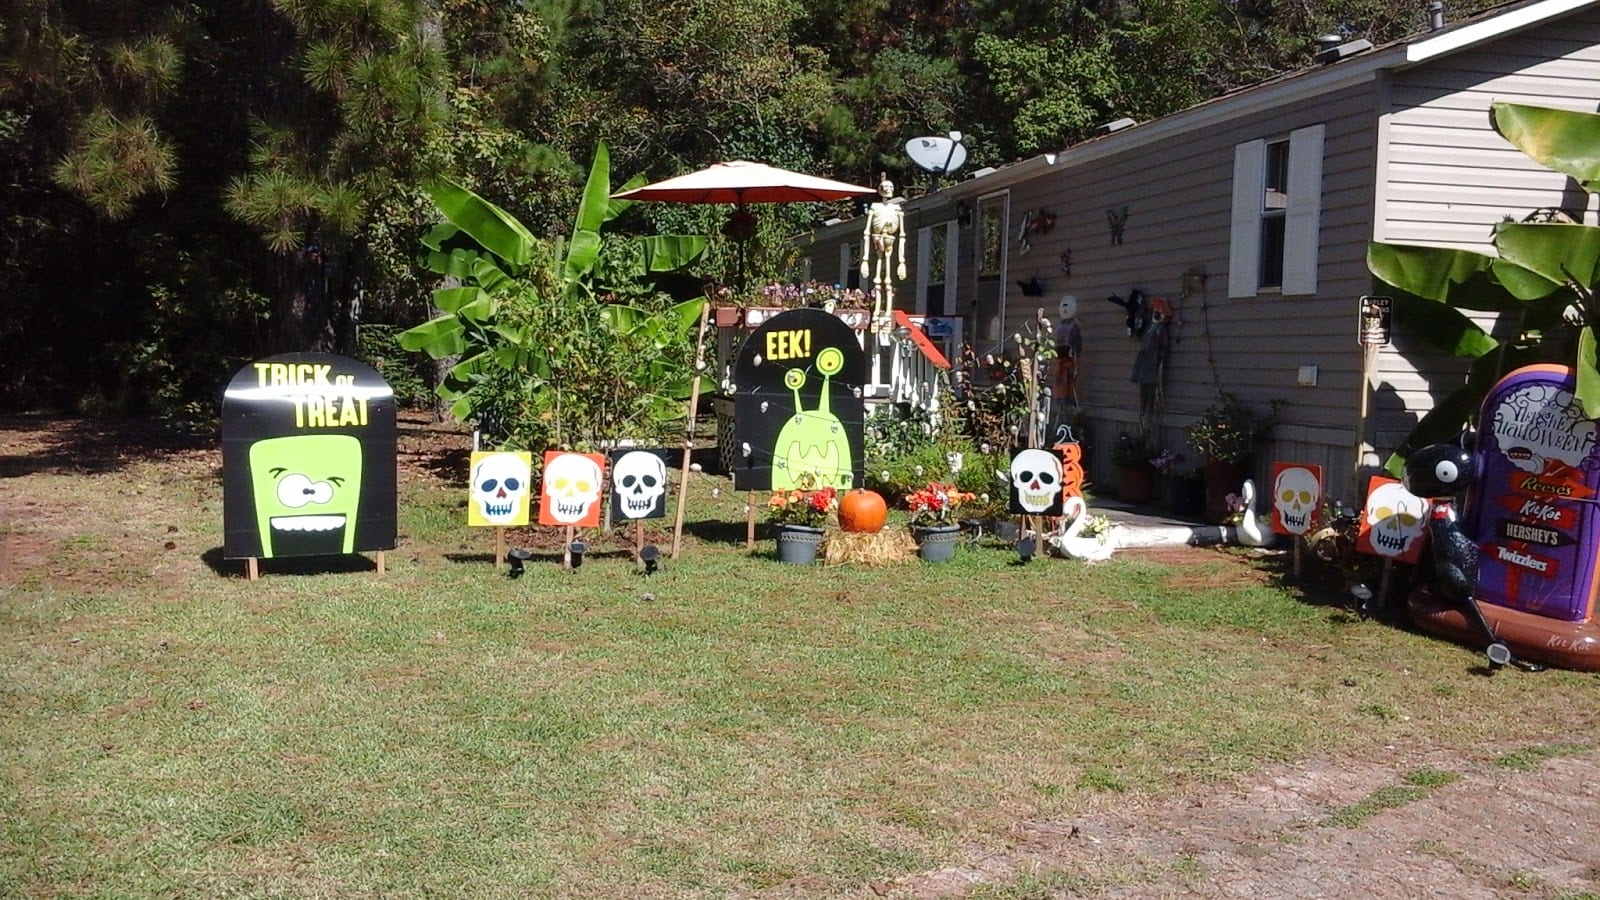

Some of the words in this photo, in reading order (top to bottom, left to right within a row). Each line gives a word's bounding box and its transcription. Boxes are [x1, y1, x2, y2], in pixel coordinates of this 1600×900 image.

[766, 329, 811, 361] EEK!
[254, 363, 331, 388] TRICK
[293, 394, 371, 428] TREAT
[1506, 523, 1559, 546] HERSHEY'S
[1497, 546, 1548, 572] Twizzlers
